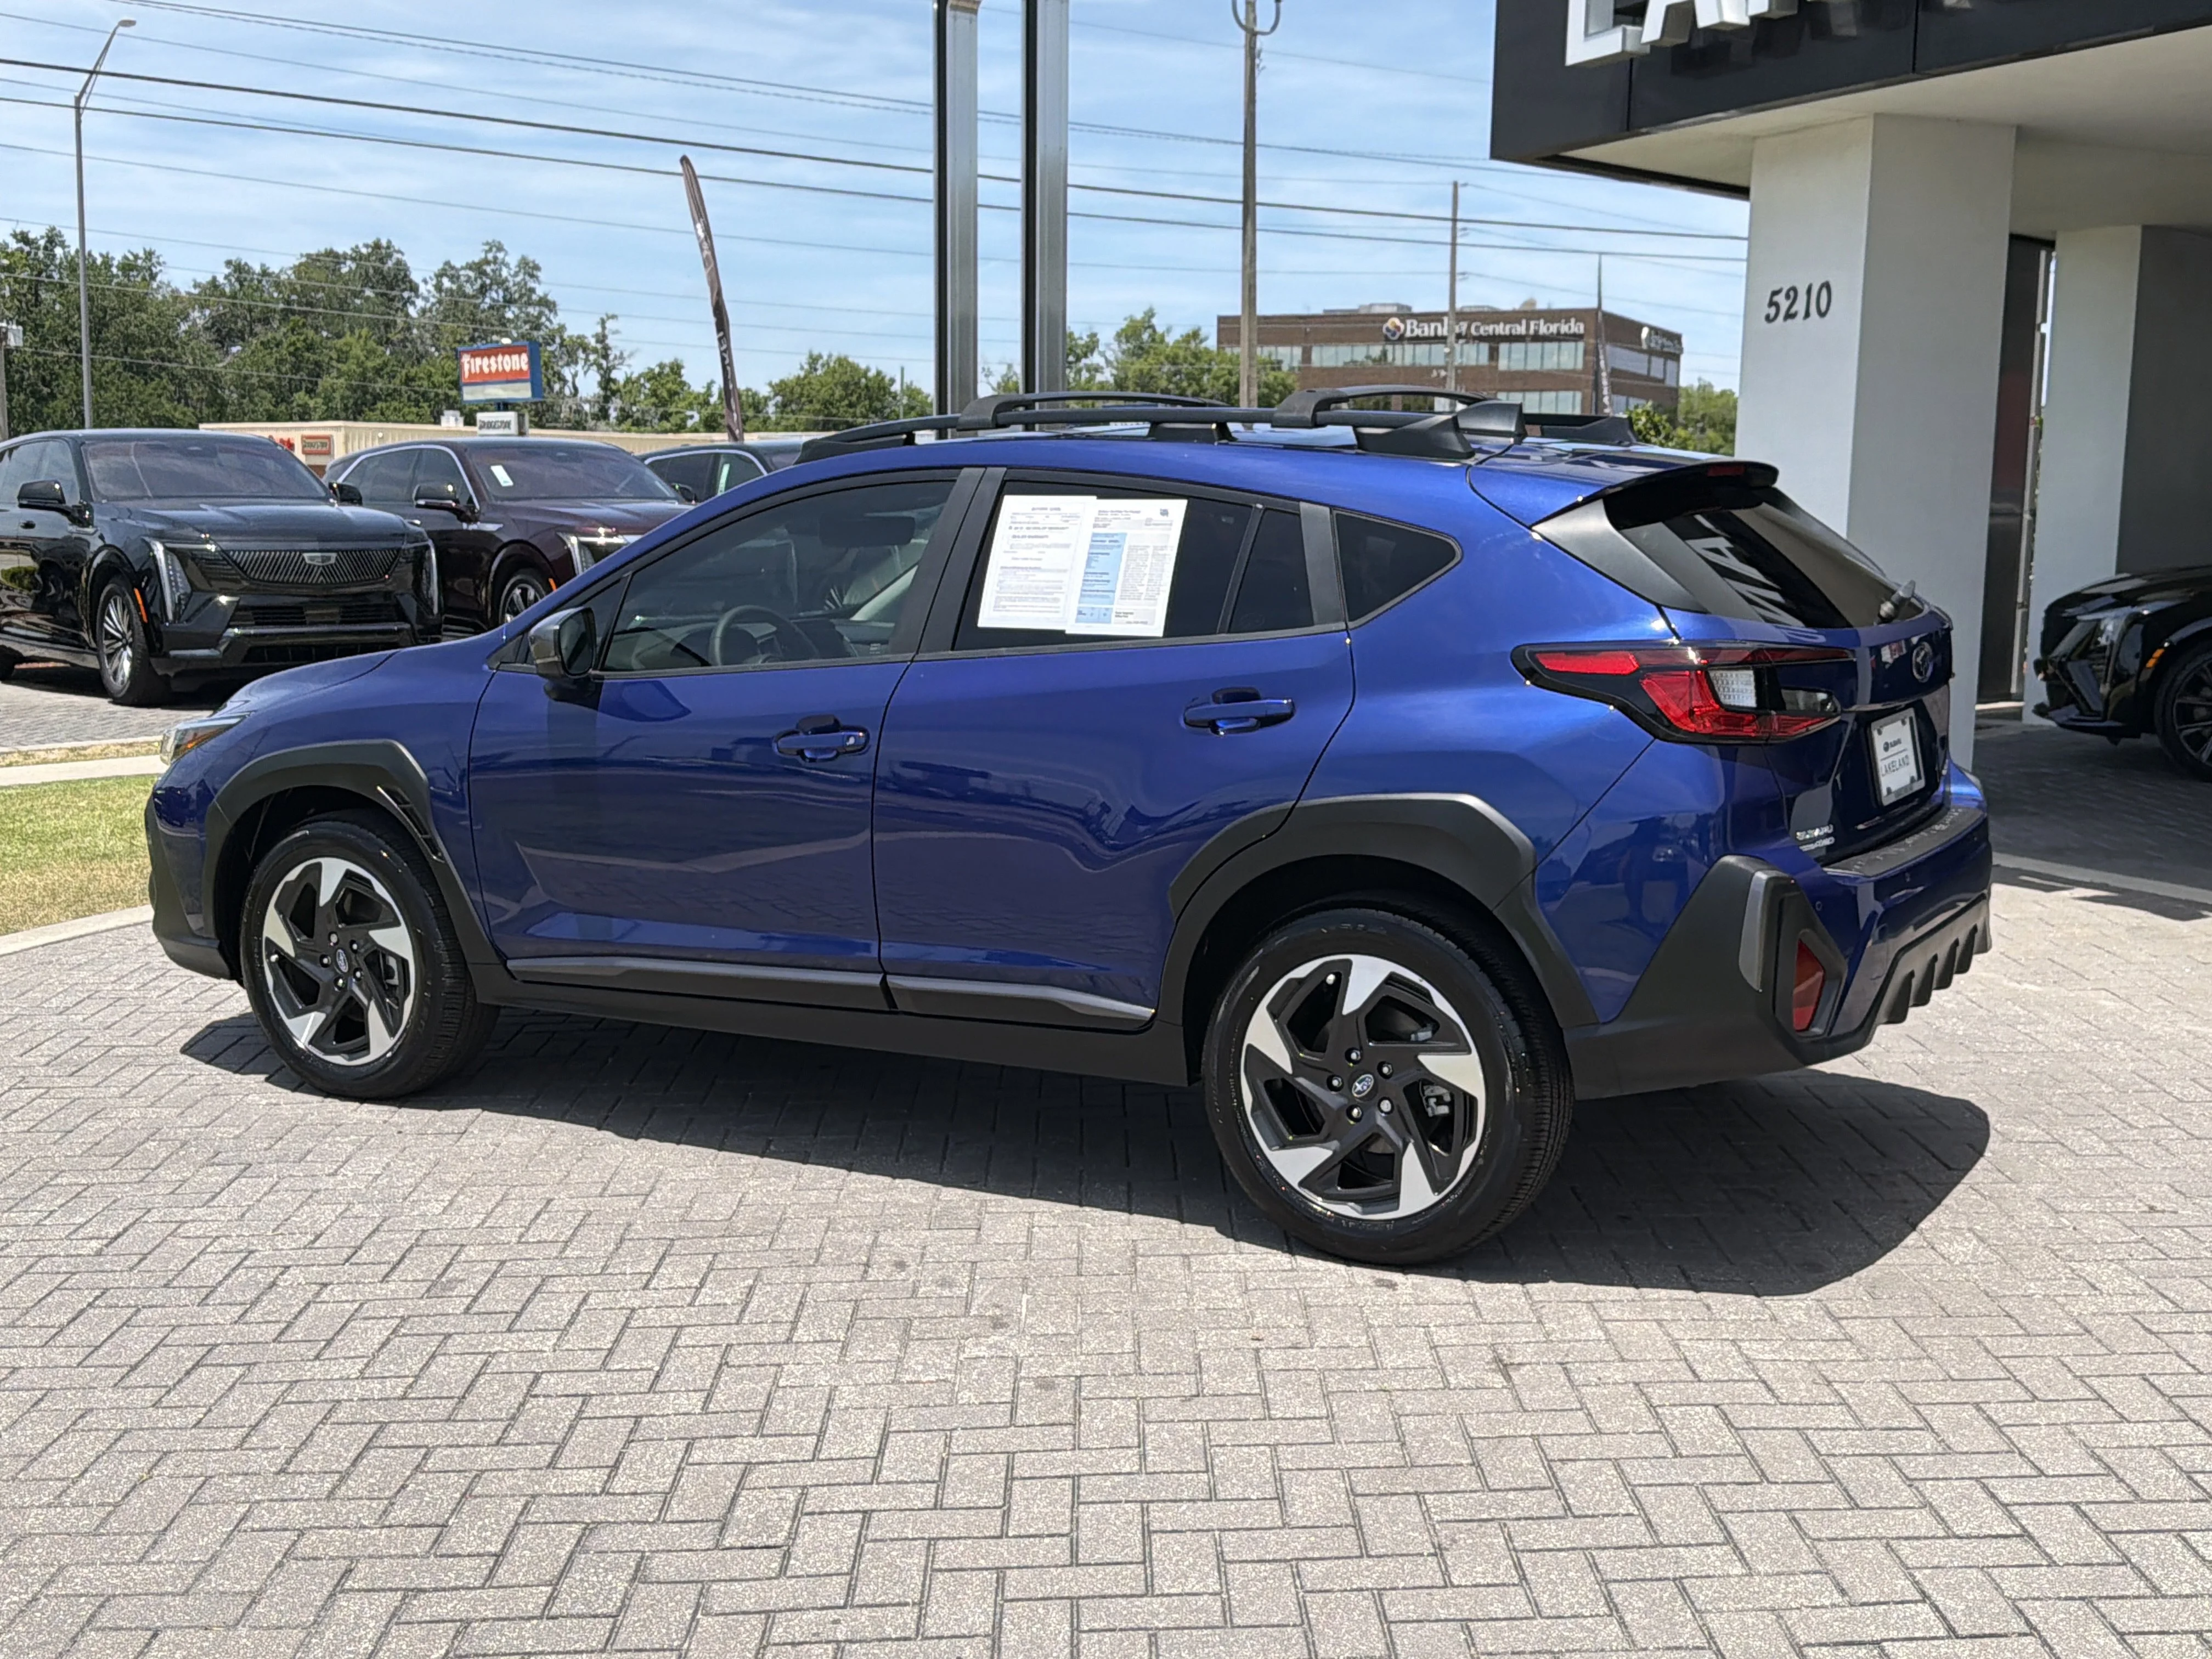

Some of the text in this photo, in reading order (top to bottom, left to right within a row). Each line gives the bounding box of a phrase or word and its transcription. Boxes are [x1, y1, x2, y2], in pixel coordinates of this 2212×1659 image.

[1764, 280, 1832, 324] 5210
[1470, 319, 1526, 336] Central
[1529, 317, 1585, 335] Florida
[461, 352, 529, 379] Firestone
